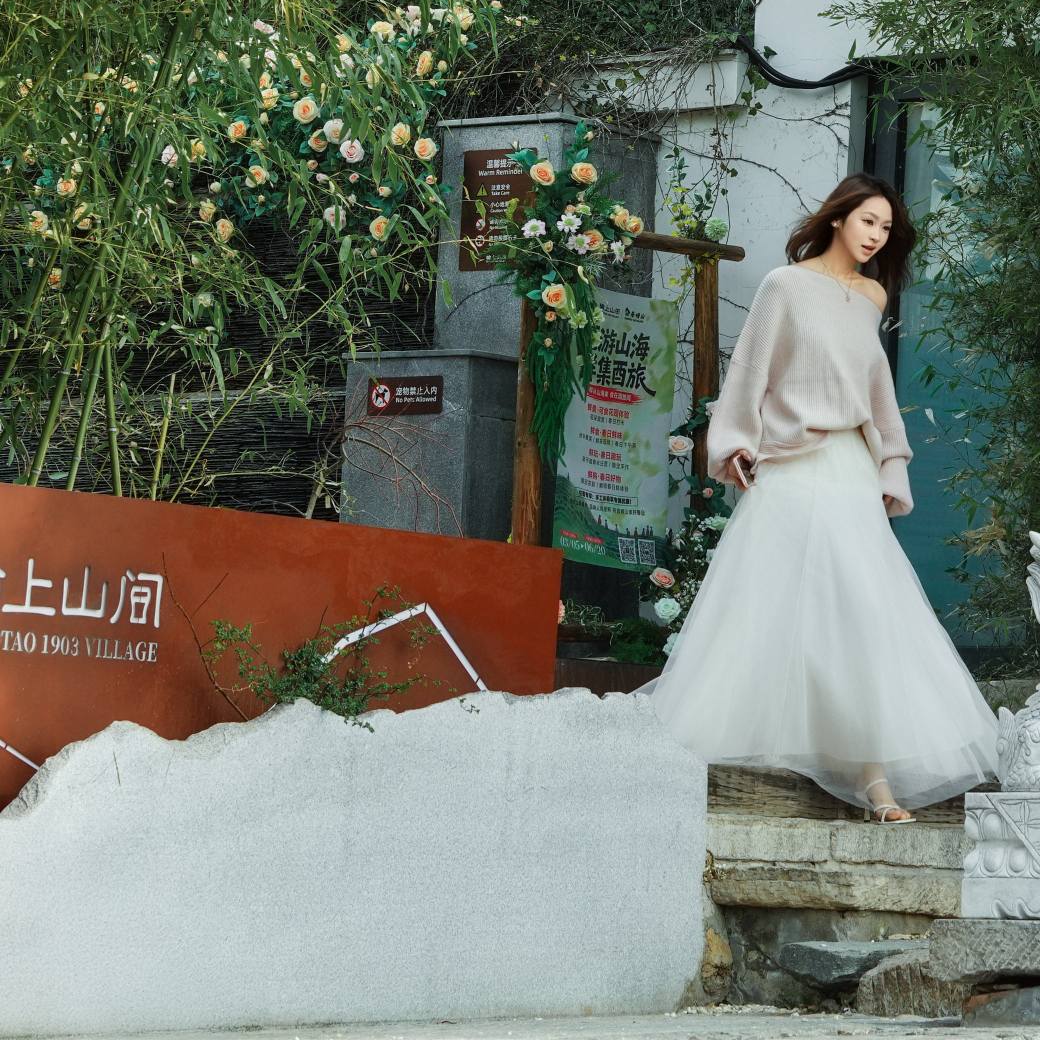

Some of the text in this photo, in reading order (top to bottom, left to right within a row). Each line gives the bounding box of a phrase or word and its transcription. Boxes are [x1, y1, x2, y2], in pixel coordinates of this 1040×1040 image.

[592, 327, 651, 362] 游山海
[396, 387, 437, 396] 宠物禁止入内
[0, 558, 163, 628] 上山间
[41, 634, 79, 657] 1903
[85, 636, 159, 663] VILLAGE
